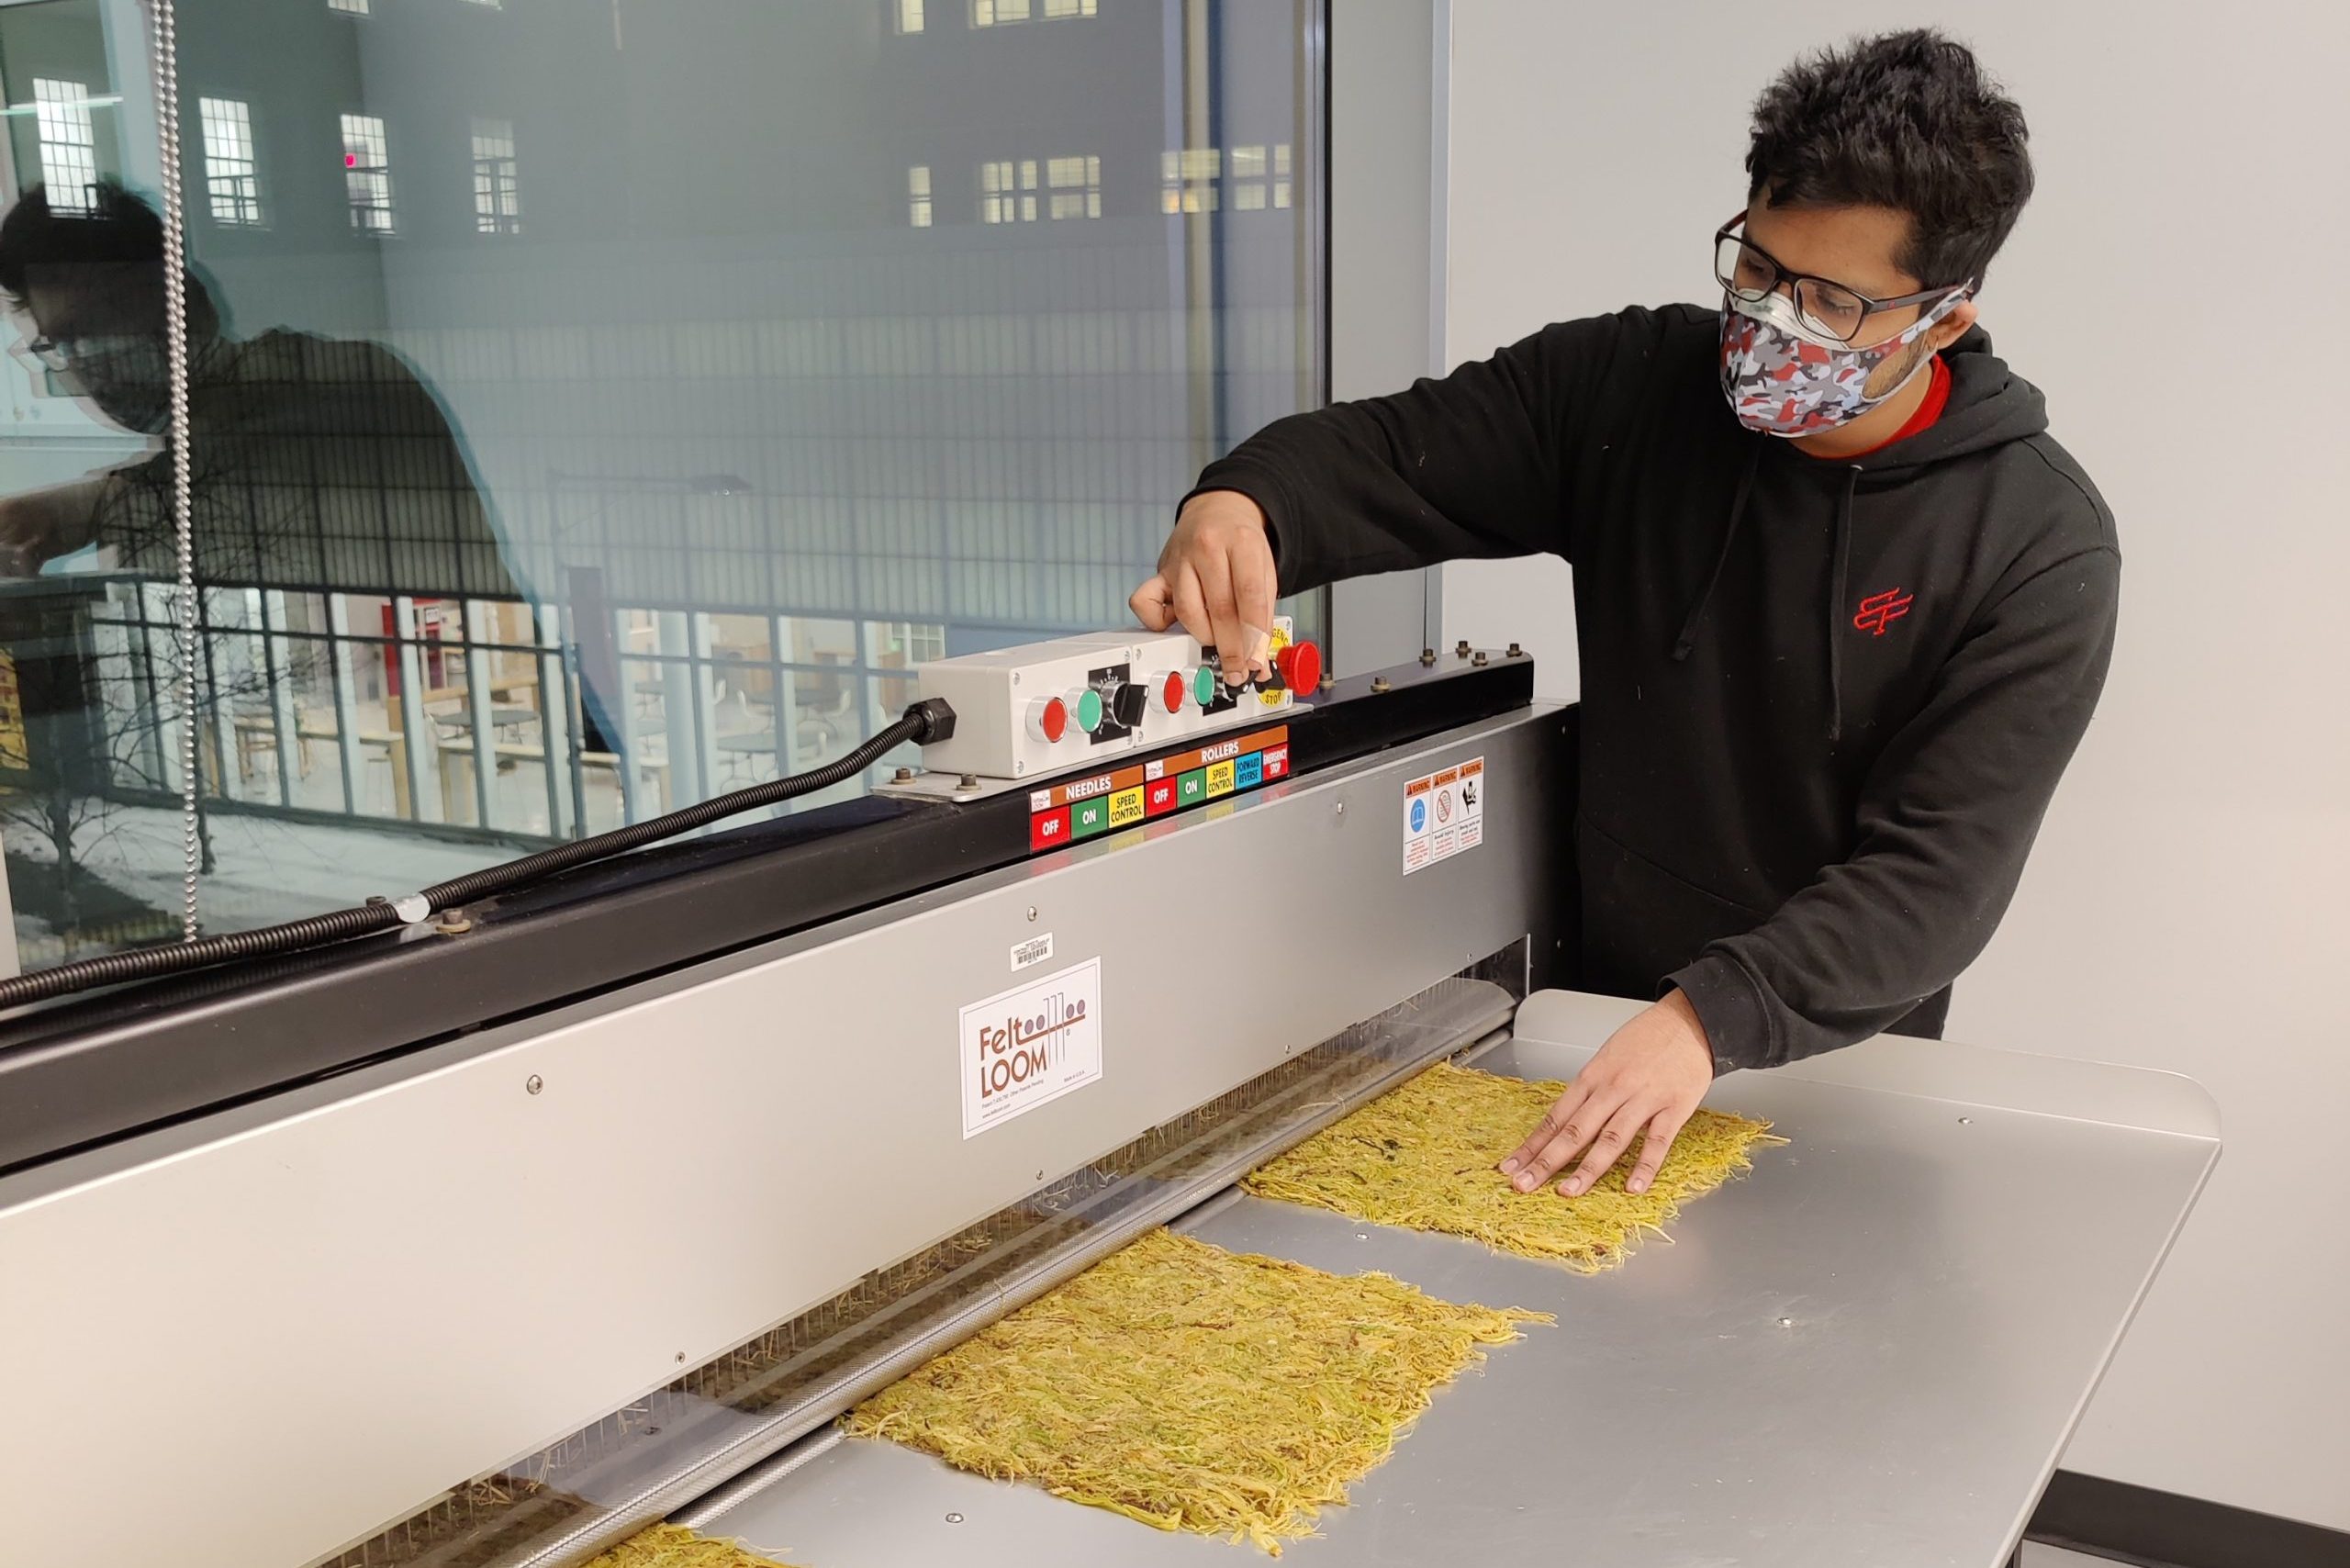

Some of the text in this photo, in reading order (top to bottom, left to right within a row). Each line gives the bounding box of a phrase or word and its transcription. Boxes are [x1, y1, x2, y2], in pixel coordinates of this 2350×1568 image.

[1265, 690, 1282, 705] STOP
[1201, 741, 1239, 763] ROLLERS
[1262, 748, 1289, 766] EMERGENCY
[1237, 756, 1260, 772] FORWARD
[1269, 762, 1282, 775] STOP
[1212, 767, 1228, 780] SPEED
[1238, 769, 1259, 784] REVERSE
[1066, 776, 1112, 801] NEEDLES
[1185, 778, 1198, 794] ON
[1207, 778, 1233, 793] CONTROL
[1116, 793, 1136, 809] SPEED
[1153, 788, 1169, 805] OFF
[1082, 809, 1097, 825] ON
[1110, 804, 1142, 823] CONTROL
[1042, 818, 1059, 836] OFF
[979, 1015, 1023, 1061] Felt
[981, 1040, 1047, 1099] LOOM
